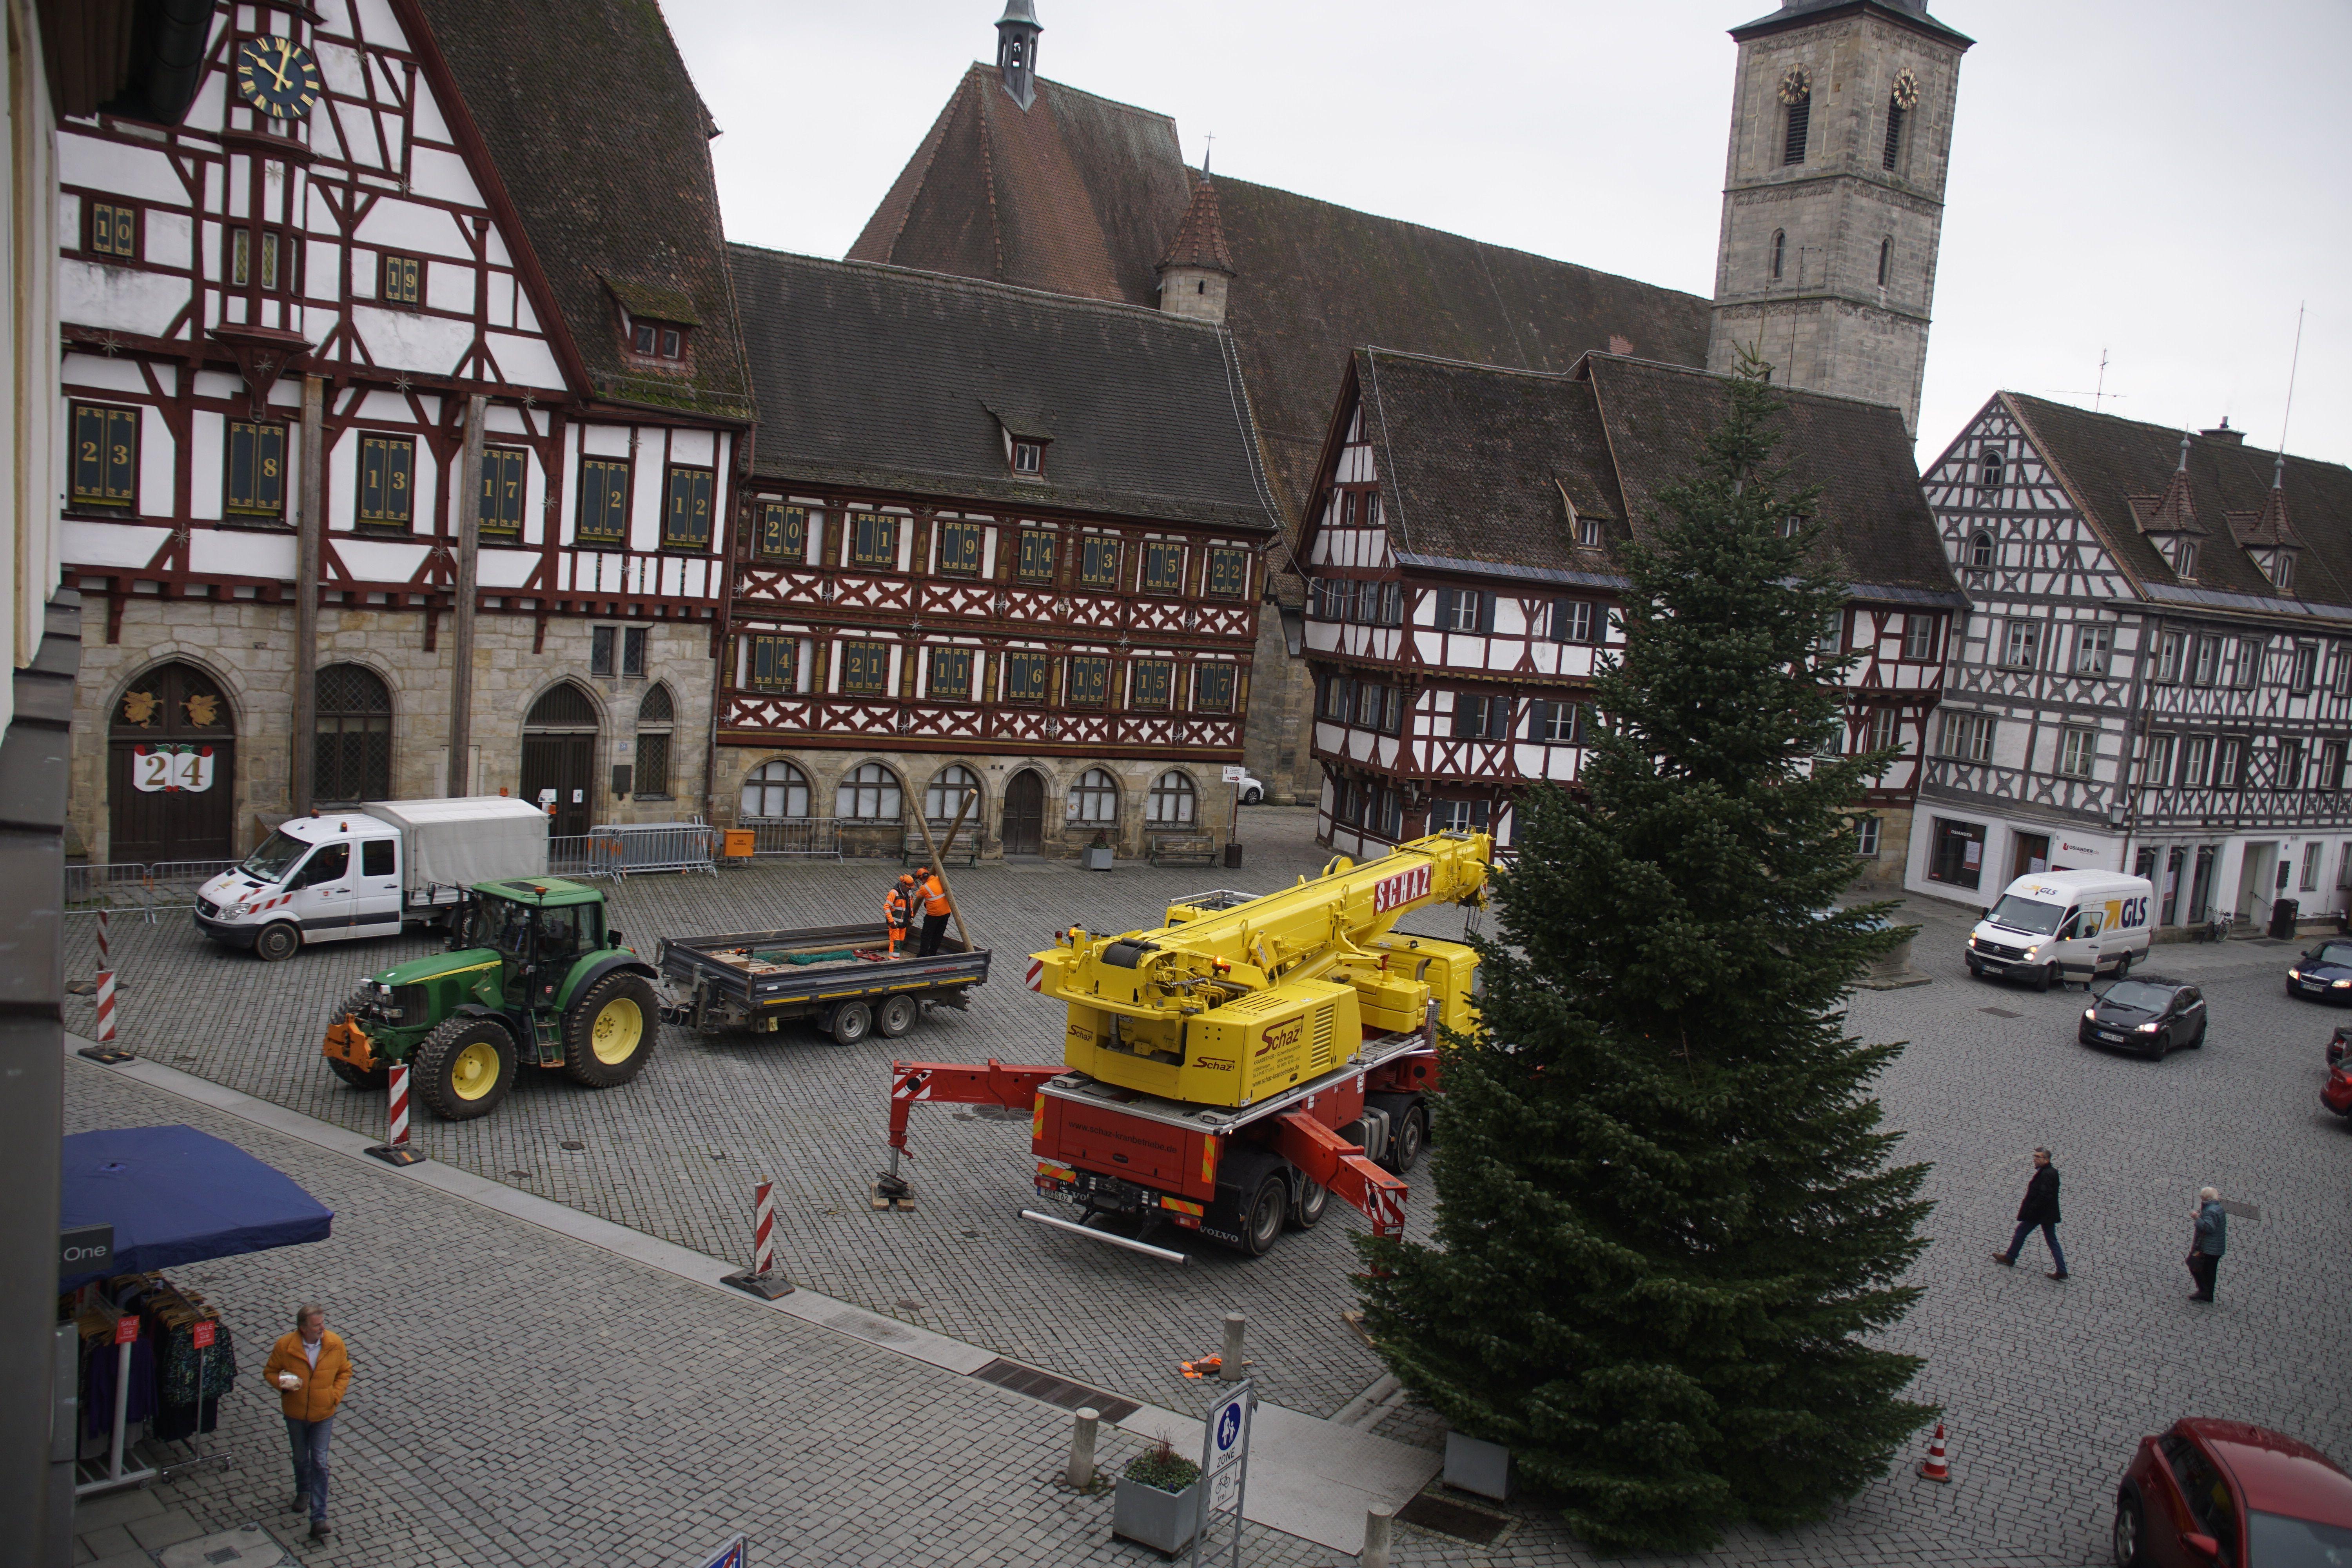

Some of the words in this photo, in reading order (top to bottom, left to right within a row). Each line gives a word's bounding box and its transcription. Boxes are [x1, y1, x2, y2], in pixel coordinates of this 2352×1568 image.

[98, 220, 129, 240] 10
[390, 270, 415, 289] 19
[82, 441, 128, 465] 23
[263, 458, 277, 477] 8
[369, 470, 405, 490] 13
[484, 479, 517, 499] 17
[610, 491, 621, 508] 2
[675, 497, 706, 515] 12
[768, 521, 799, 539] 20
[880, 531, 888, 547] 1
[965, 539, 975, 554] 9
[1025, 545, 1051, 562] 14
[1103, 554, 1113, 568] 3
[1167, 559, 1176, 573] 5
[1216, 563, 1240, 579] 22
[779, 653, 789, 668] 4
[851, 657, 878, 674] 21
[938, 662, 963, 679] 11
[1033, 669, 1042, 684] 6
[1077, 671, 1103, 687] 18
[1140, 674, 1165, 690] 15
[1220, 677, 1230, 692] 7
[145, 756, 203, 786] 24
[1377, 867, 1429, 912] SCHAZ
[2121, 897, 2147, 928] GLS
[1067, 1024, 1093, 1042] Schaz
[1254, 1014, 1303, 1057] Schaz
[1192, 1056, 1235, 1072] Schaz
[1253, 1053, 1274, 1065] KRANBETRIEB
[1252, 1064, 1299, 1088] www.schaz-kranbetriebe.de
[1069, 1121, 1177, 1153] www.schaz-kranbetriebe.de
[1045, 1189, 1052, 1198] ER
[1061, 1193, 1068, 1201] 62
[1200, 1225, 1239, 1242] VOLVO
[64, 1246, 107, 1261] One
[196, 1323, 214, 1332] SALE
[1217, 1446, 1235, 1468] ZONE
[1218, 1490, 1226, 1502] frei
